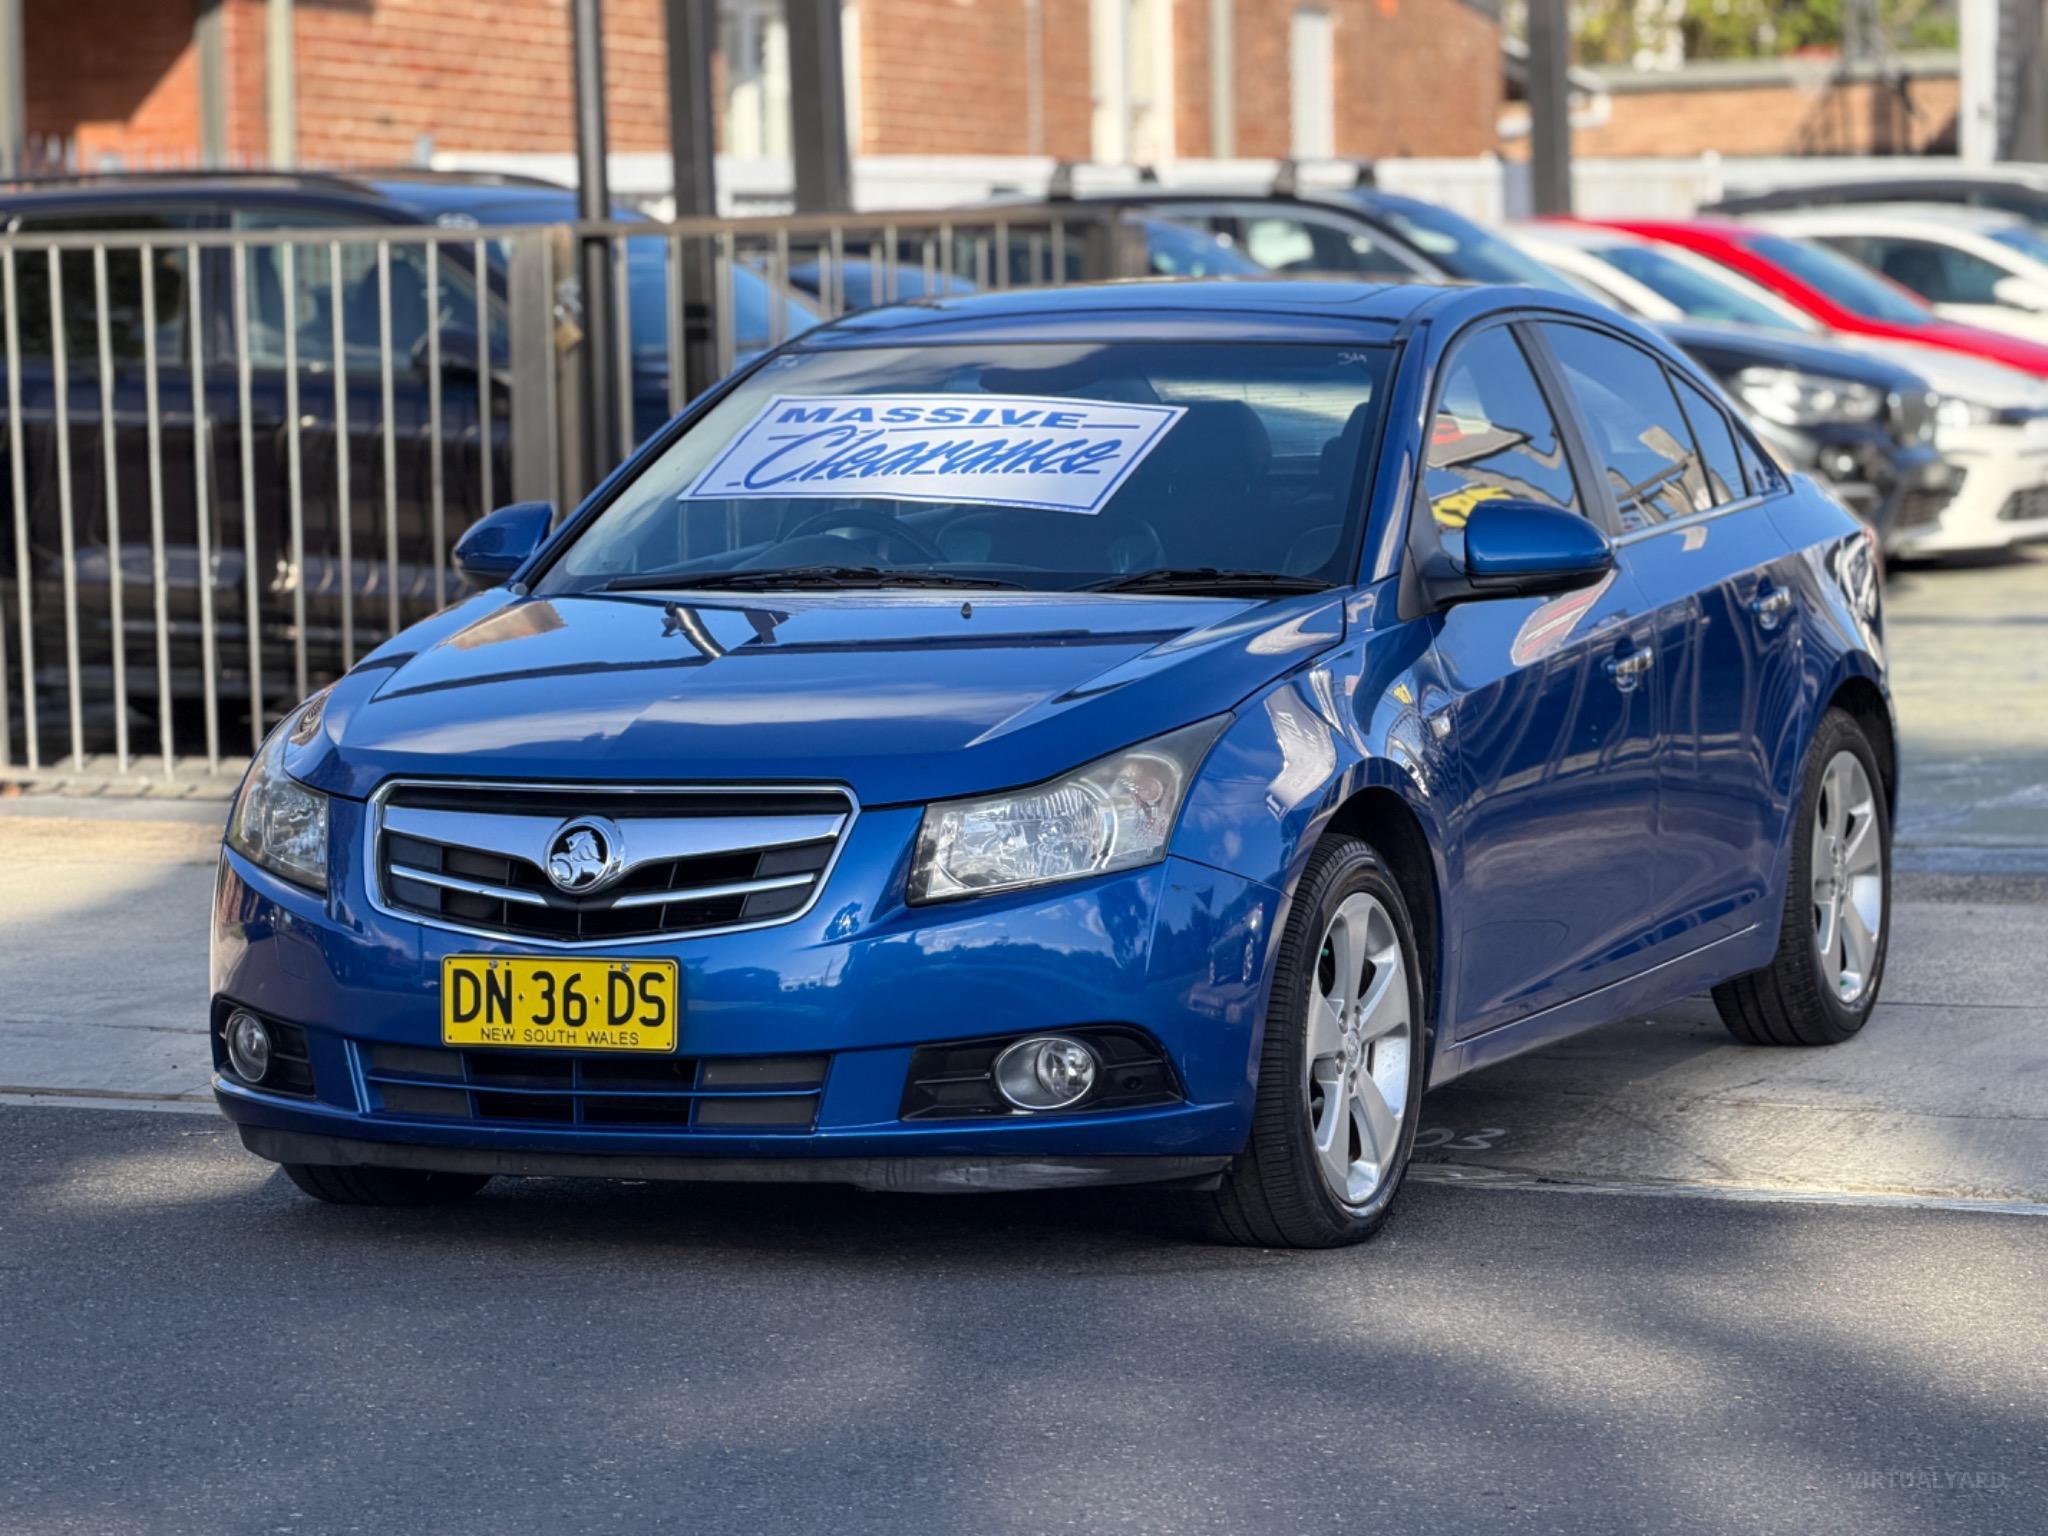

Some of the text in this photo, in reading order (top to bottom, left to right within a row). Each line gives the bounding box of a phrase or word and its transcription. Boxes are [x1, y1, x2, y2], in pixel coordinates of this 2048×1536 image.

[775, 406, 1089, 429] MASSIVE
[741, 424, 1123, 490] Clearance
[480, 1027, 640, 1046] NEW SOUTH WALES
